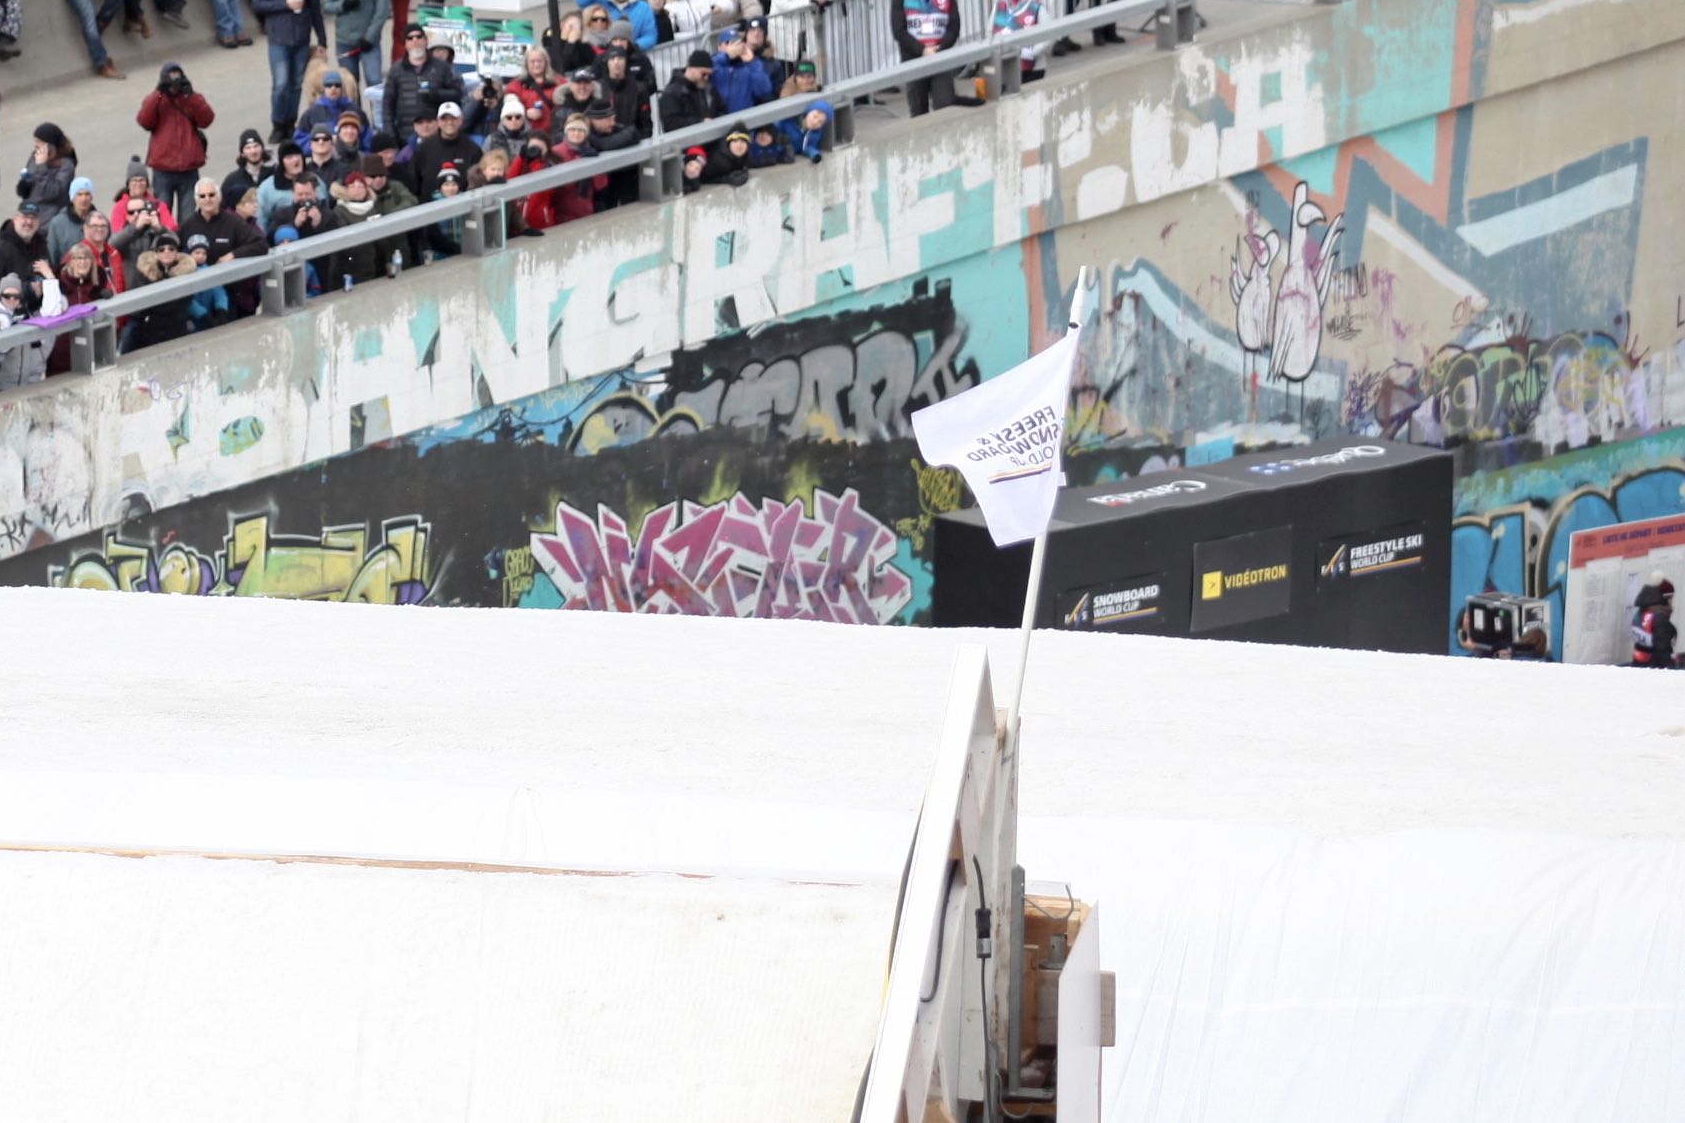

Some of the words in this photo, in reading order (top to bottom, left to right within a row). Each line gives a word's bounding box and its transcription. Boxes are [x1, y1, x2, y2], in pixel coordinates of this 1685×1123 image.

[1350, 536, 1405, 559] FREESTYLE
[1405, 533, 1423, 549] SKI
[1350, 555, 1377, 571] WORLD
[1378, 552, 1394, 566] CUP
[1224, 564, 1287, 590] VIDÉOTRON
[1092, 585, 1159, 608] SNOWBOARD
[1092, 603, 1121, 619] WORLD
[1122, 600, 1140, 614] CUP
